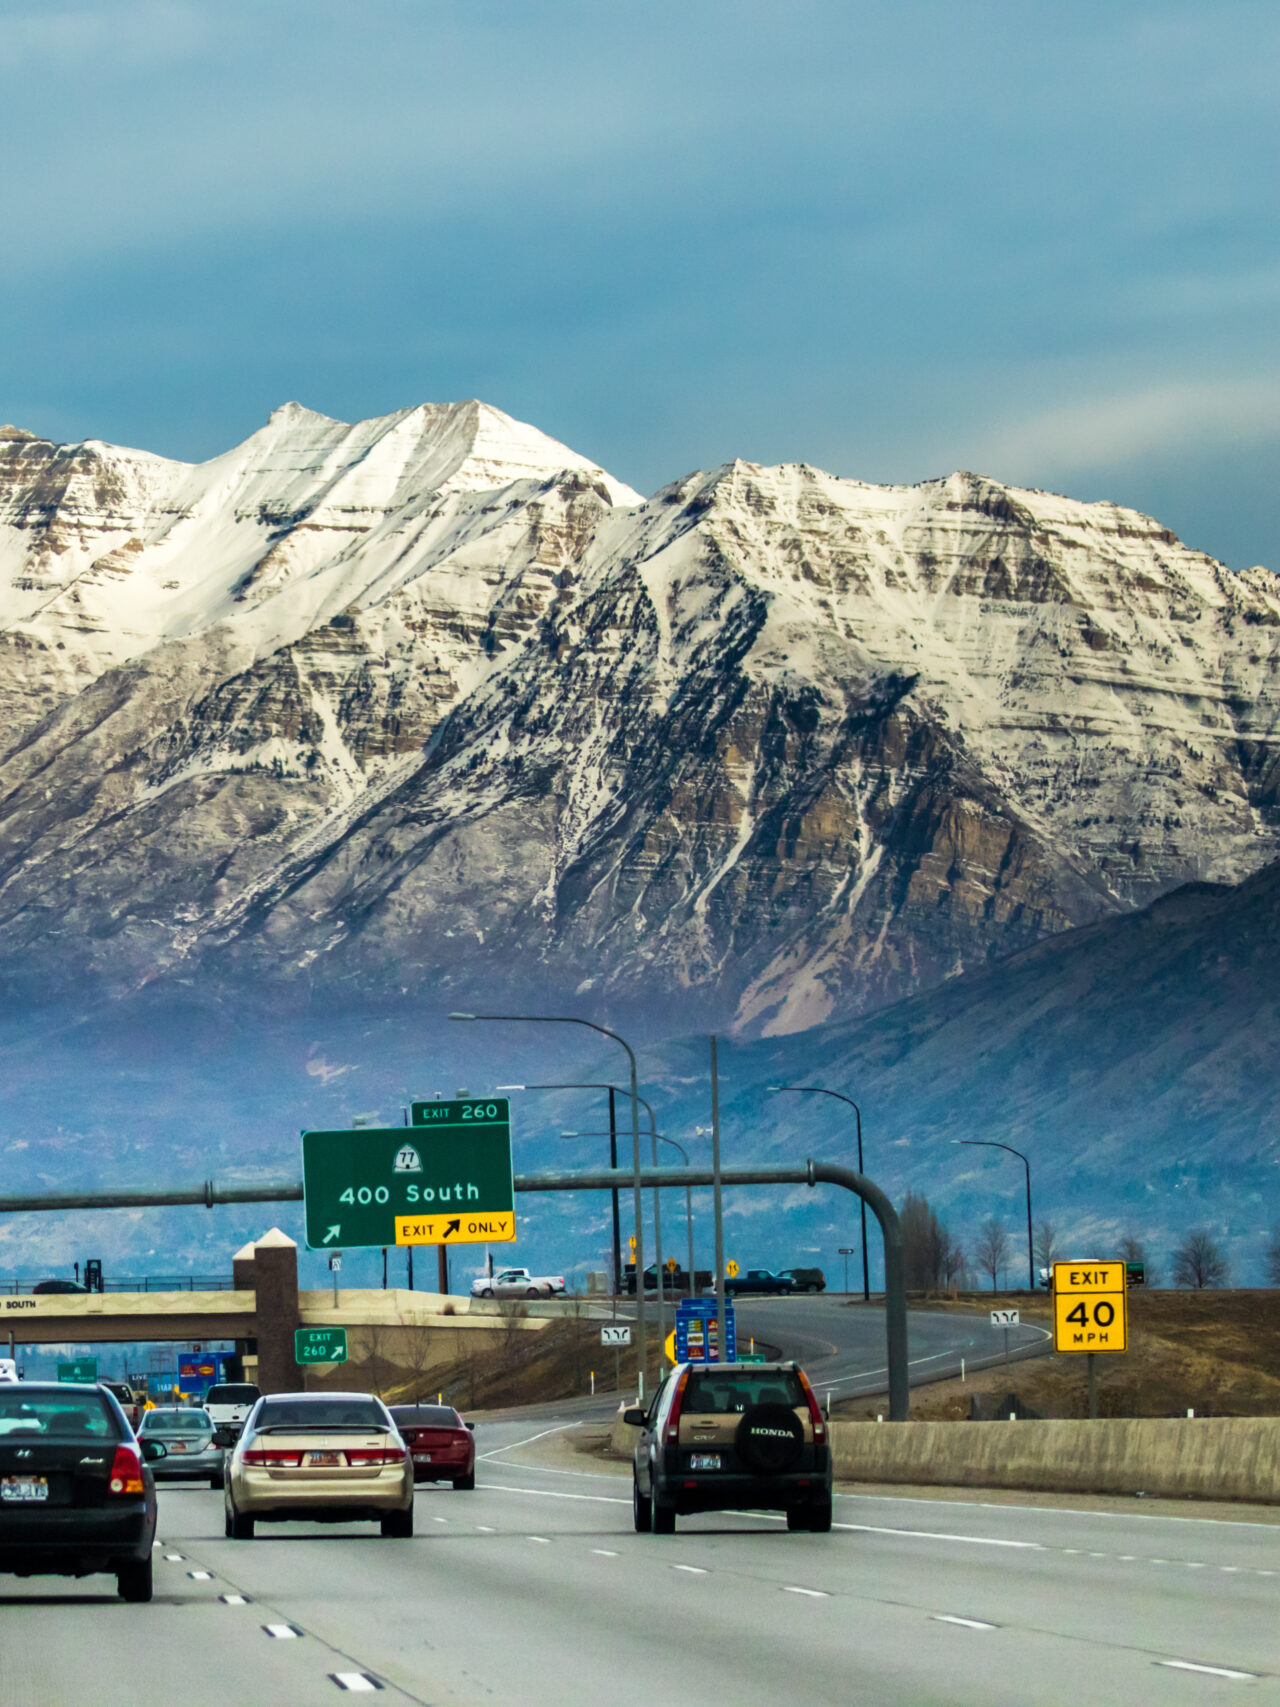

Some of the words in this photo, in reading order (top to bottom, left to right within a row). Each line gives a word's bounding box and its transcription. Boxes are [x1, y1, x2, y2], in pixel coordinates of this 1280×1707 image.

[423, 1108, 449, 1118] EXIT
[462, 1104, 497, 1118] 260
[400, 1152, 414, 1163] 77
[339, 1186, 389, 1204] 400
[406, 1182, 479, 1201] South
[403, 1224, 434, 1236] EXIT
[468, 1221, 507, 1233] ONLY
[1070, 1271, 1109, 1285] EXIT
[6, 1300, 36, 1309] SOUTH
[1065, 1301, 1115, 1327] 40
[309, 1333, 332, 1342] EXIT
[1073, 1332, 1109, 1343] MPH
[303, 1345, 326, 1357] 260
[750, 1427, 795, 1438] HONDA
